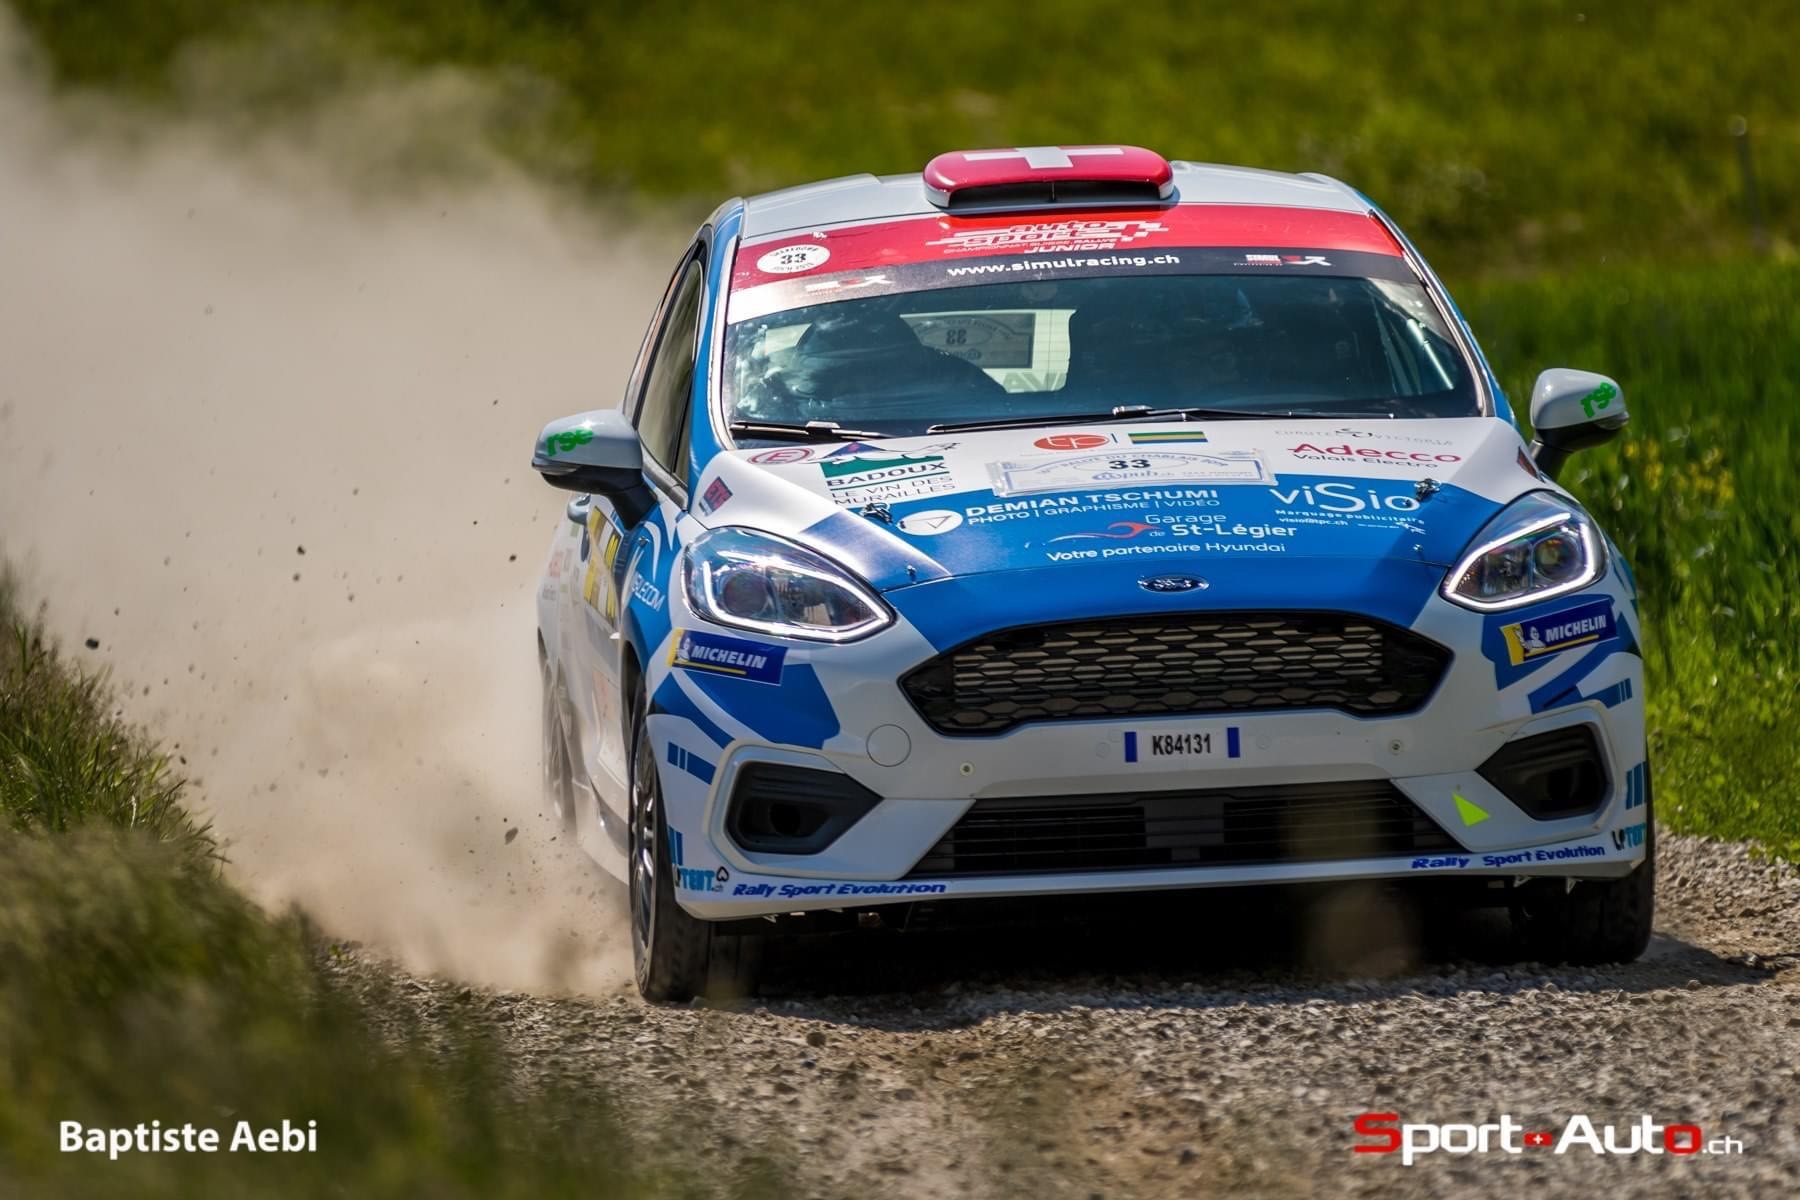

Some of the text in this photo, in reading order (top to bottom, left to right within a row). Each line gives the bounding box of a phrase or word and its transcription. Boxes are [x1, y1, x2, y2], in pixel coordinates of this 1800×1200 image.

[964, 230, 1079, 246] sport
[1024, 243, 1115, 254] JUNIOR
[780, 252, 807, 265] 33
[947, 255, 1180, 277] www.simulracing.ch
[1287, 443, 1461, 462] Adecco
[1293, 453, 1438, 468] Valais Electro
[827, 462, 948, 487] BADOUX
[1108, 458, 1151, 470] 33
[832, 476, 953, 499] LE VIN DES
[834, 483, 956, 505] MURAILLES
[1269, 482, 1421, 512] viSio
[965, 489, 1218, 517] DEMIAN TSCHUMI
[968, 498, 1221, 525] PHOTO GRAPHISME VIDÉO
[1275, 509, 1343, 518] Marquage
[1145, 513, 1227, 525] Garage
[1150, 523, 1297, 539] de St-Légier
[1047, 541, 1286, 562] Votre partenaire Hyundai
[1545, 615, 1607, 643] MICHELIN
[691, 645, 768, 669] MICHELIN
[1152, 733, 1212, 756] K84131
[1411, 846, 1606, 869] Rally Sport Evolution
[733, 882, 946, 898] Rally Sport Evolution
